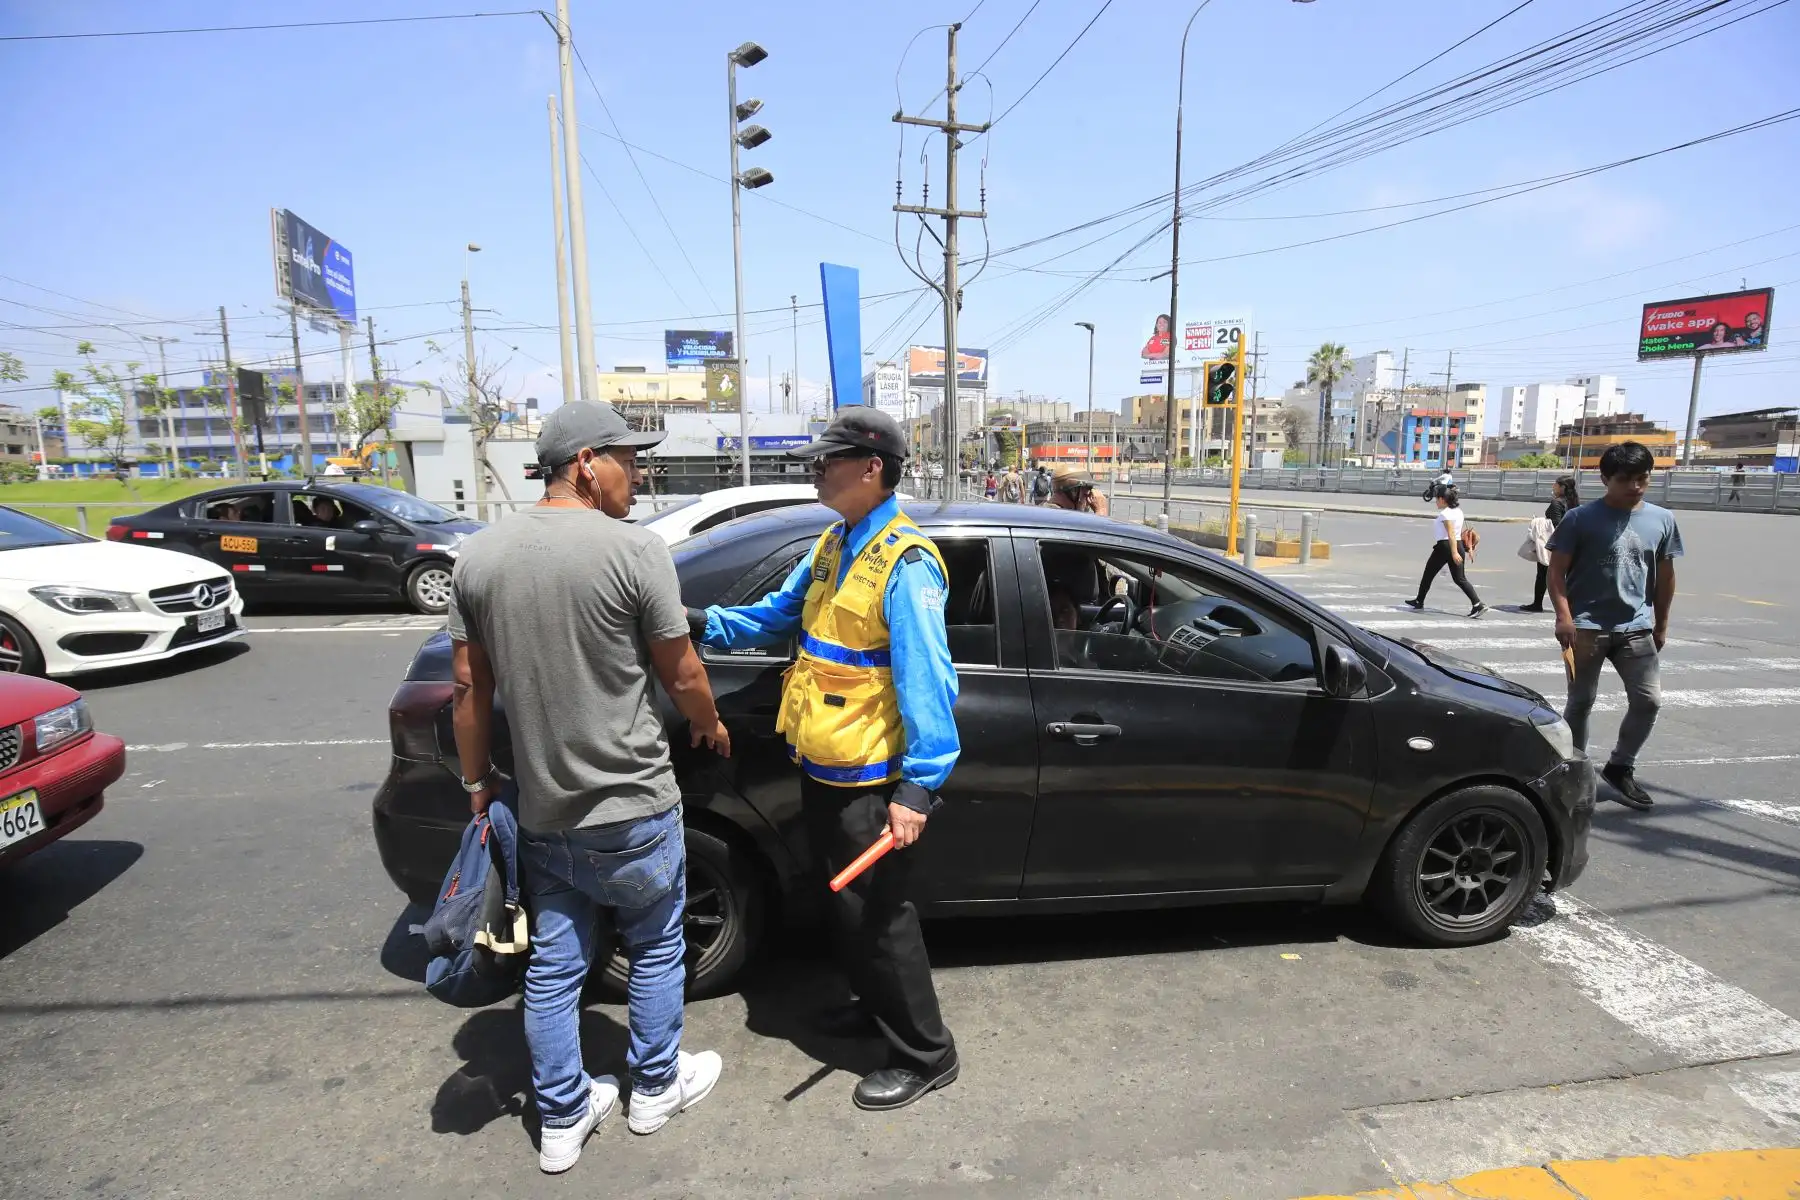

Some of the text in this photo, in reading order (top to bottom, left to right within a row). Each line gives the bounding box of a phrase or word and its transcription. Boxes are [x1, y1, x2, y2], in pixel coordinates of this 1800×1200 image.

[1647, 317, 1716, 331] wake app
[1186, 327, 1212, 337] VAMOS
[1217, 327, 1241, 344] 20
[1668, 342, 1695, 350] Mena
[880, 382, 899, 390] LASER
[781, 439, 809, 447] Angamos
